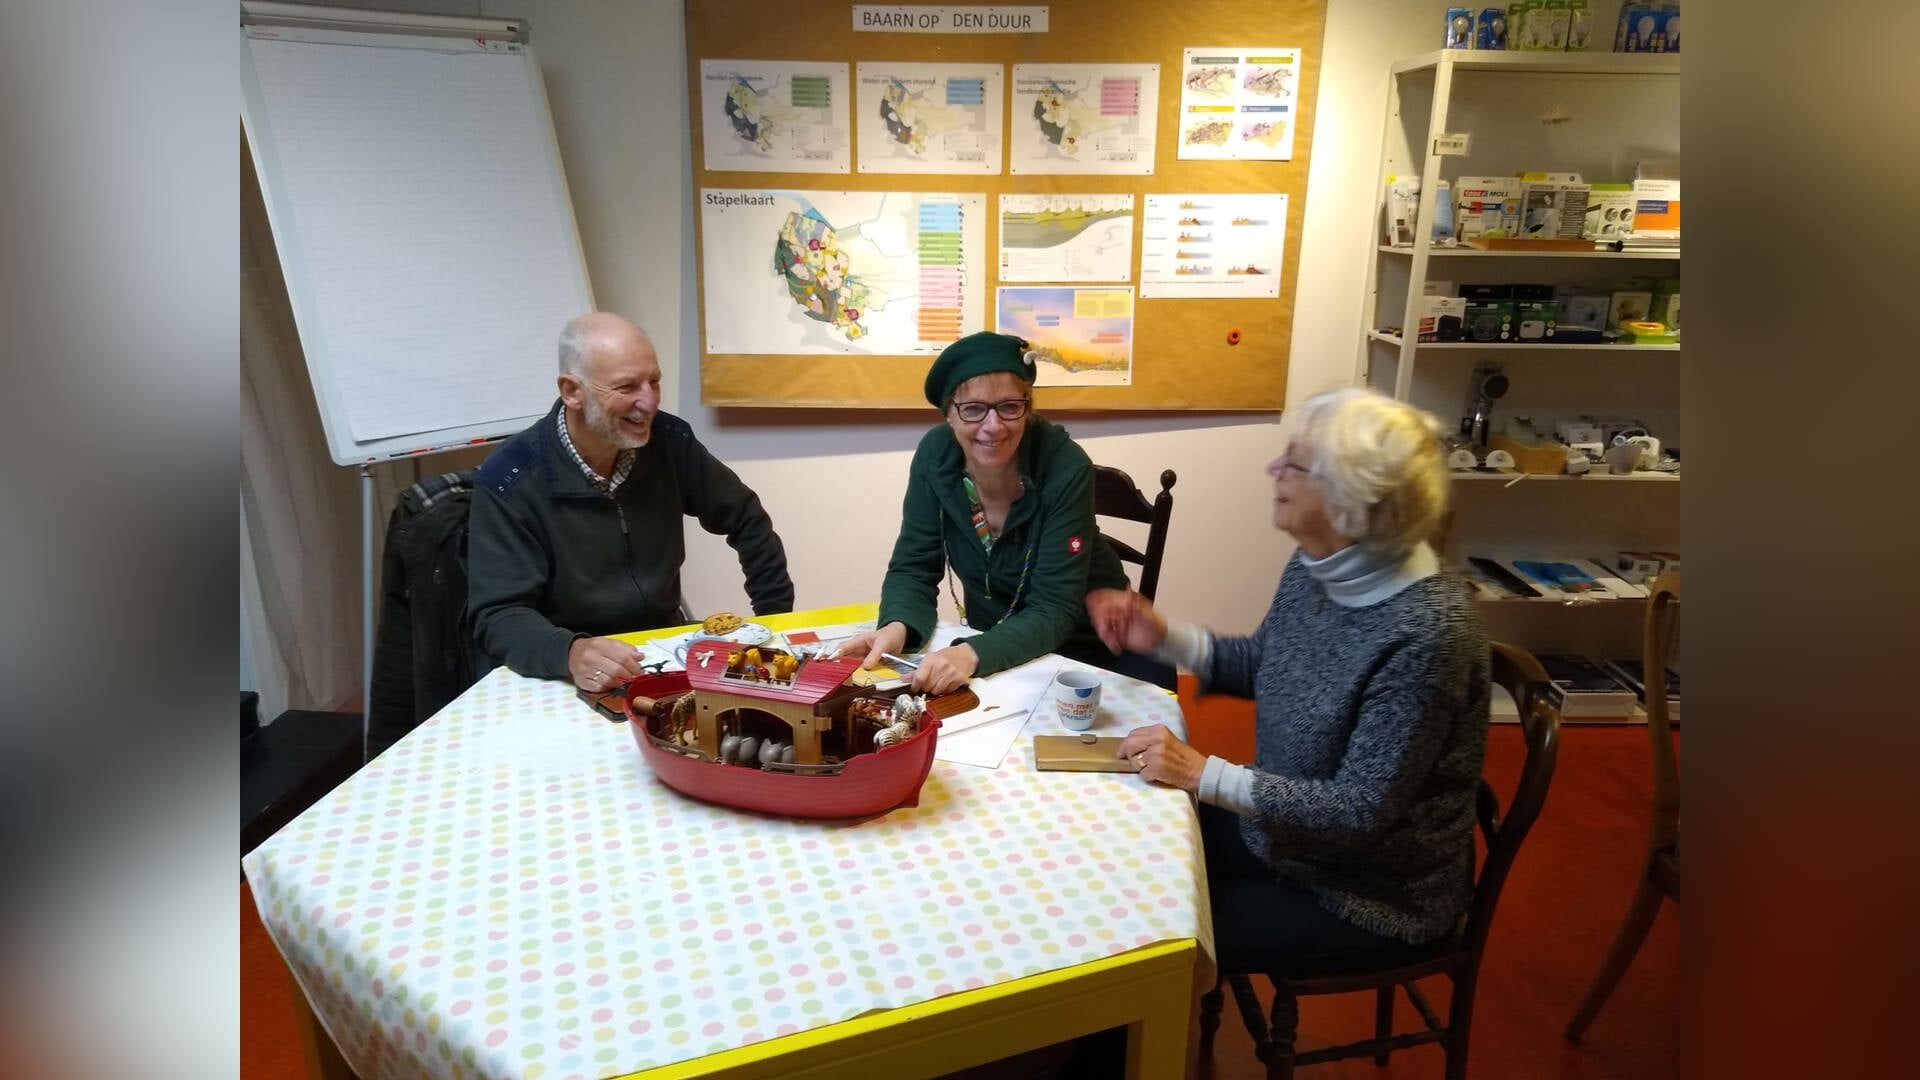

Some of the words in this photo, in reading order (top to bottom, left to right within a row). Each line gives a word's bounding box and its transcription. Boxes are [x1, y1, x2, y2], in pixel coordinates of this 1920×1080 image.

[863, 12, 914, 28] BAARN
[918, 14, 940, 29] OP
[953, 13, 983, 28] DEN
[988, 14, 1031, 29] DUUR
[706, 193, 775, 208] Stapelkaart
